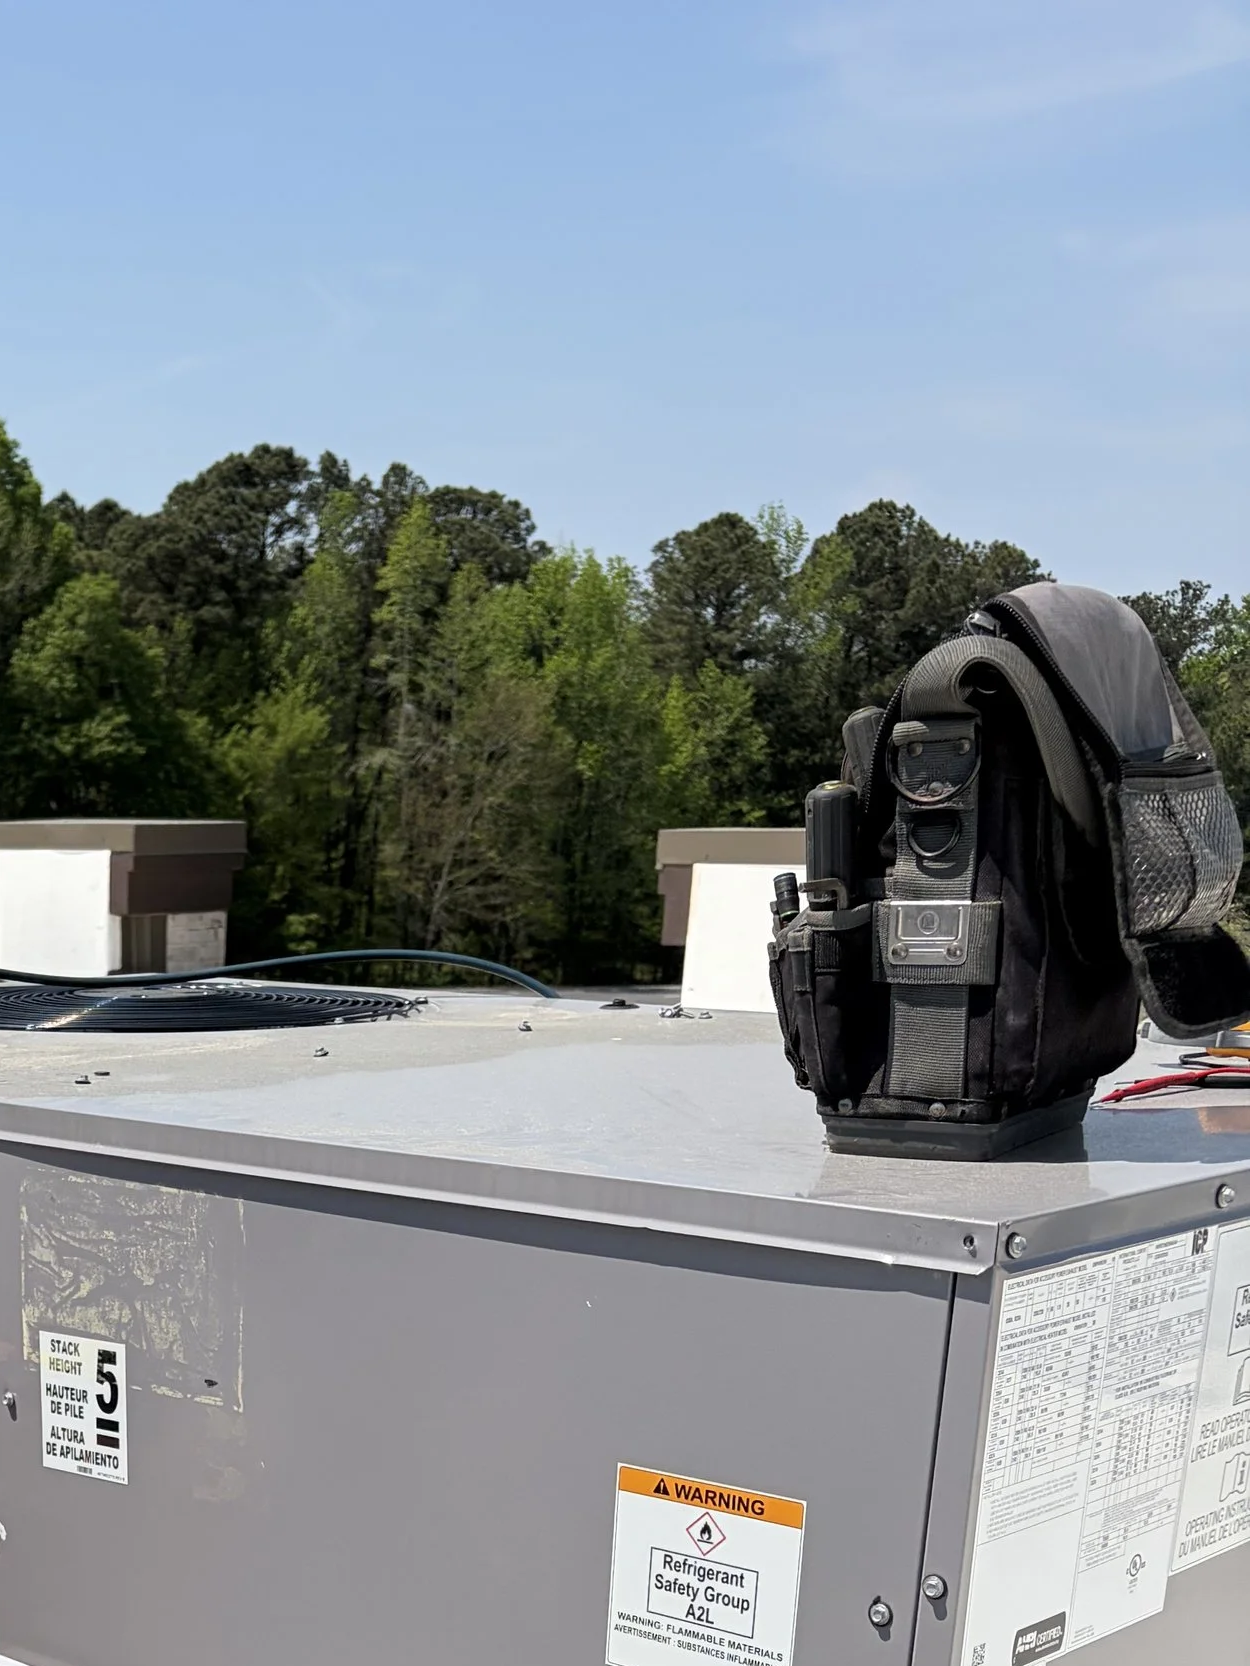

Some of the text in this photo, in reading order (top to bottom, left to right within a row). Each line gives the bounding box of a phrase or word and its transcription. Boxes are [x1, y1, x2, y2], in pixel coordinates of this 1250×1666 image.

[50, 1339, 80, 1357] STACK
[49, 1357, 82, 1375] HEIGHT
[46, 1383, 88, 1404] HAUTEUR
[96, 1349, 118, 1414] 5
[51, 1400, 84, 1419] DE PILE
[50, 1425, 85, 1445] ALTURA
[46, 1442, 119, 1469] DE APILAMIENTO
[674, 1483, 765, 1516] WARNING
[663, 1554, 745, 1588] Refrigerant
[654, 1573, 750, 1614] Safety Group
[685, 1603, 714, 1624] A2L
[614, 1623, 671, 1646] AVERTISSEMENT
[677, 1639, 725, 1661] SUBSTANCES
[617, 1611, 783, 1662] WARNING: FLAMMABLE MATERIALS
